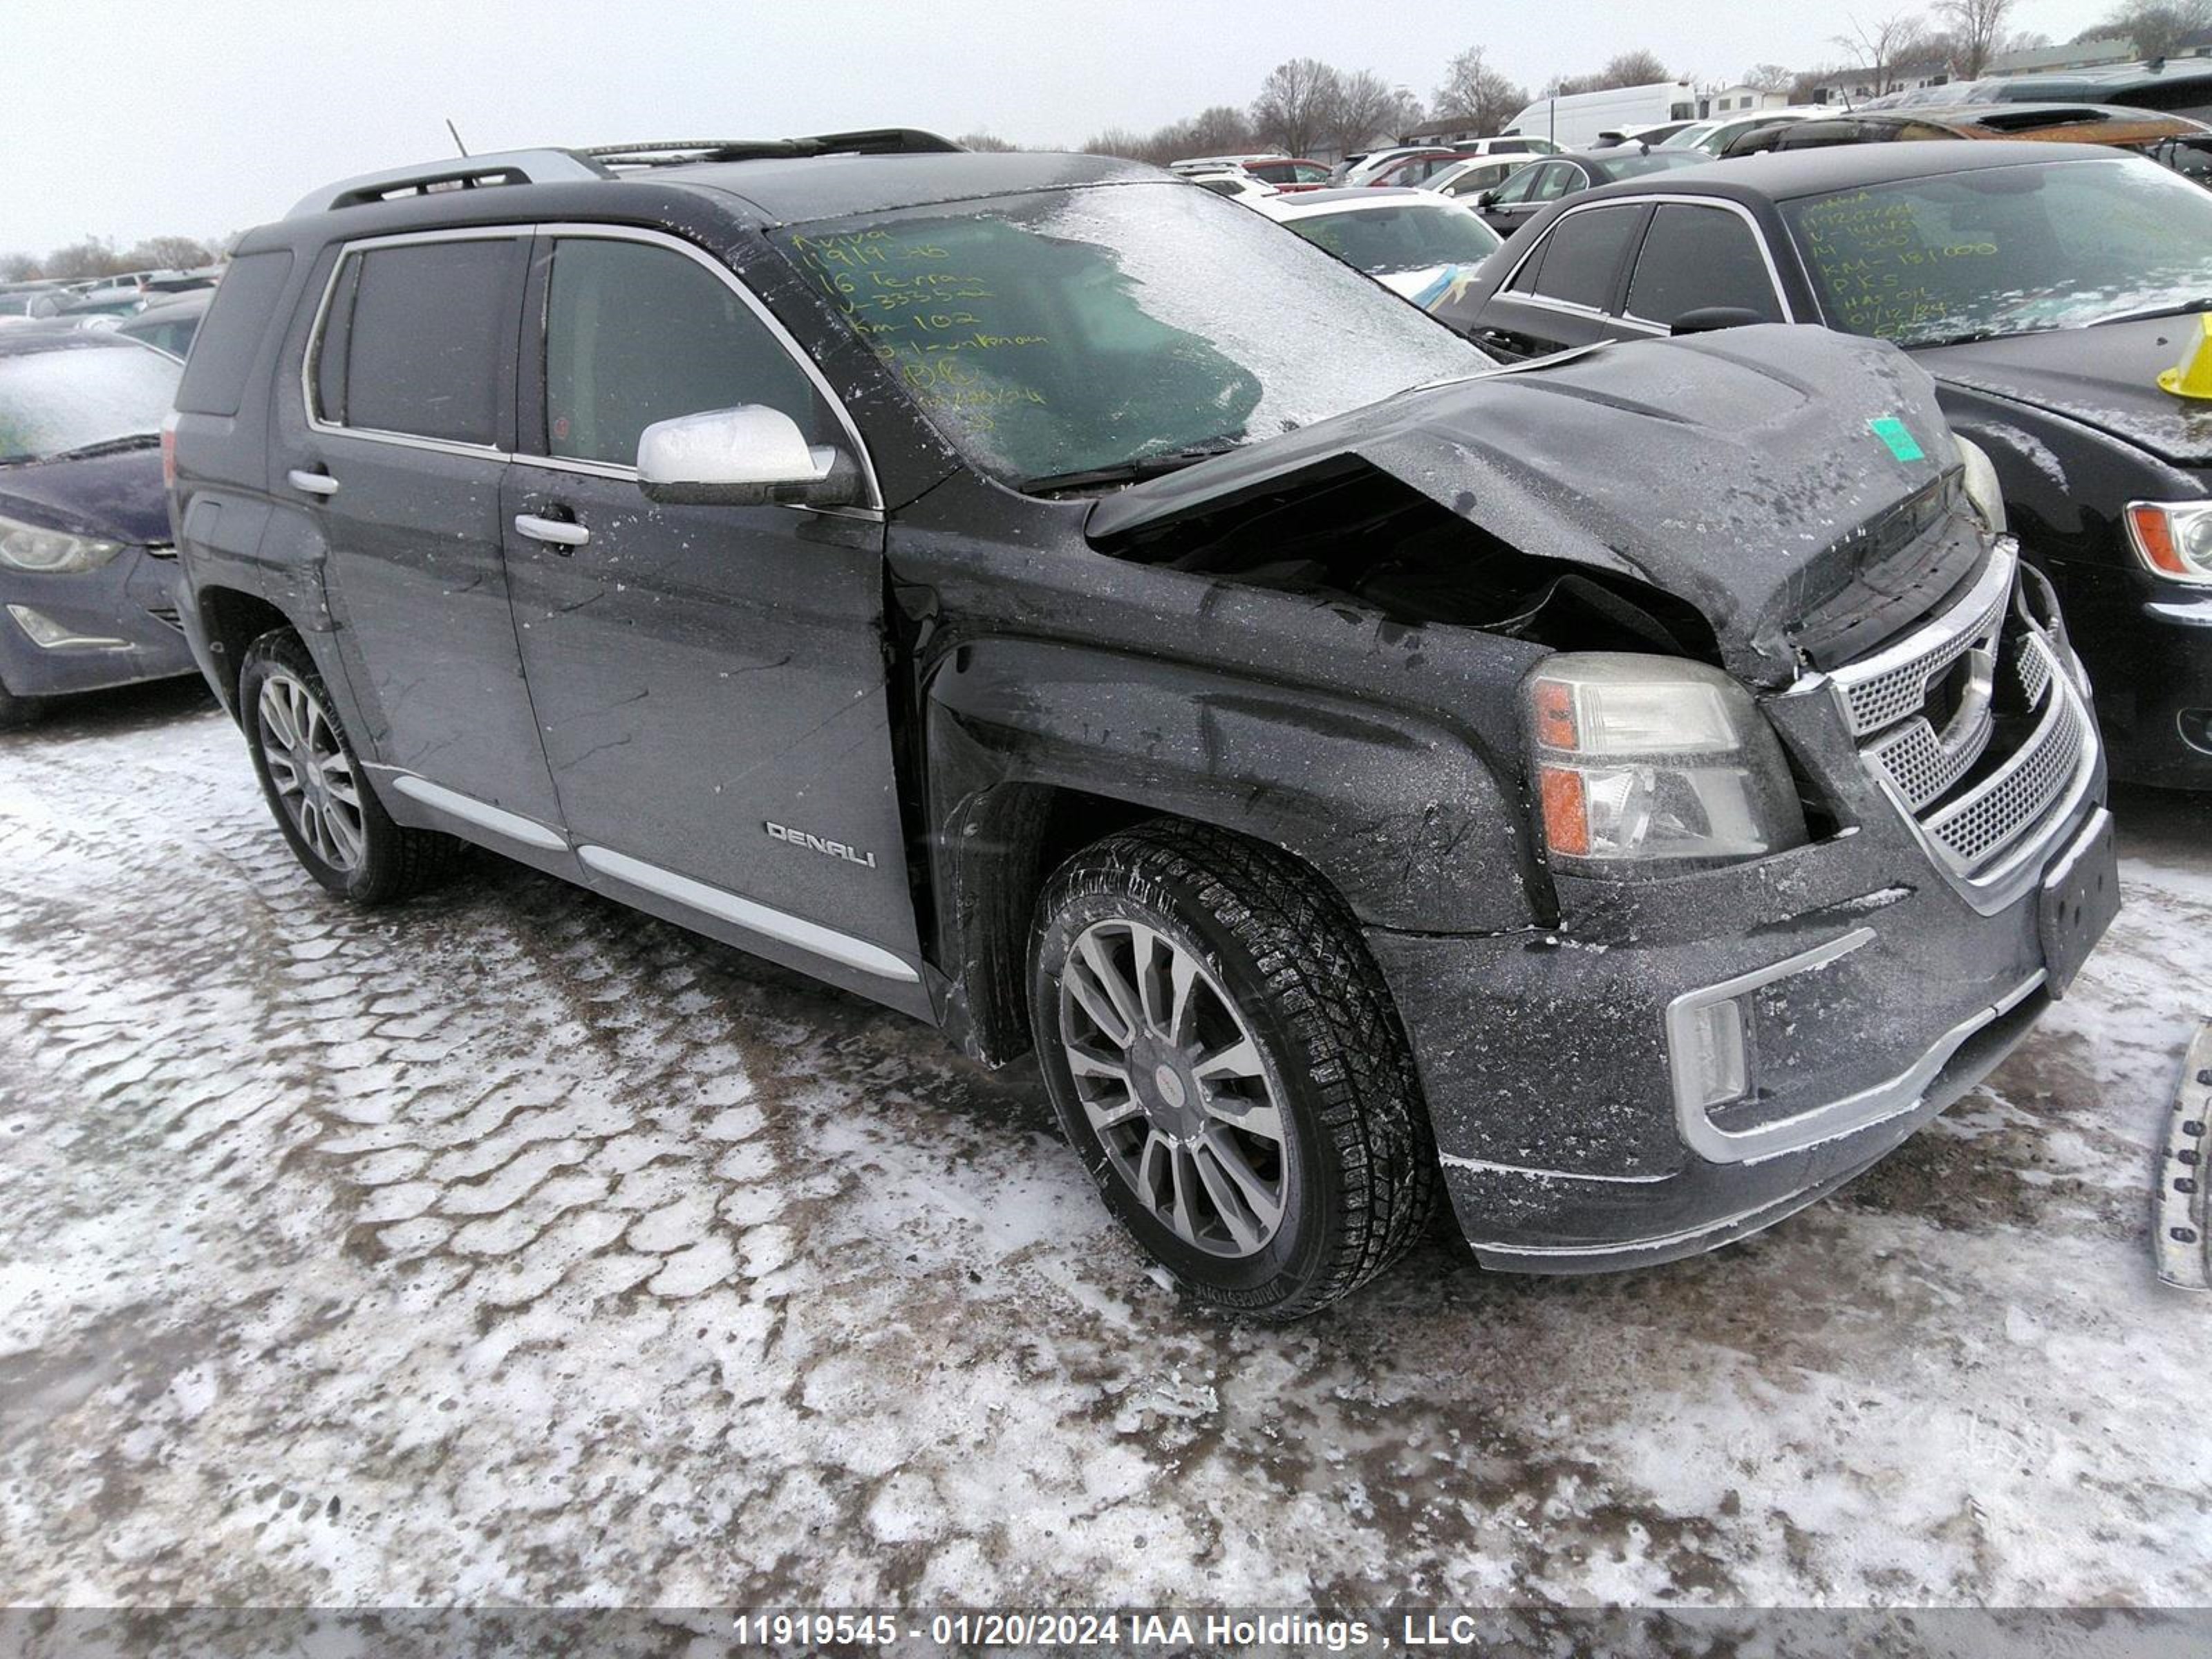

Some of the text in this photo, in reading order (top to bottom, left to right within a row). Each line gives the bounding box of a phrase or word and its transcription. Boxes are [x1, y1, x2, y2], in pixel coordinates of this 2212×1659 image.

[819, 273, 856, 294] 16
[913, 312, 982, 331] 102
[765, 821, 876, 868] DENALI
